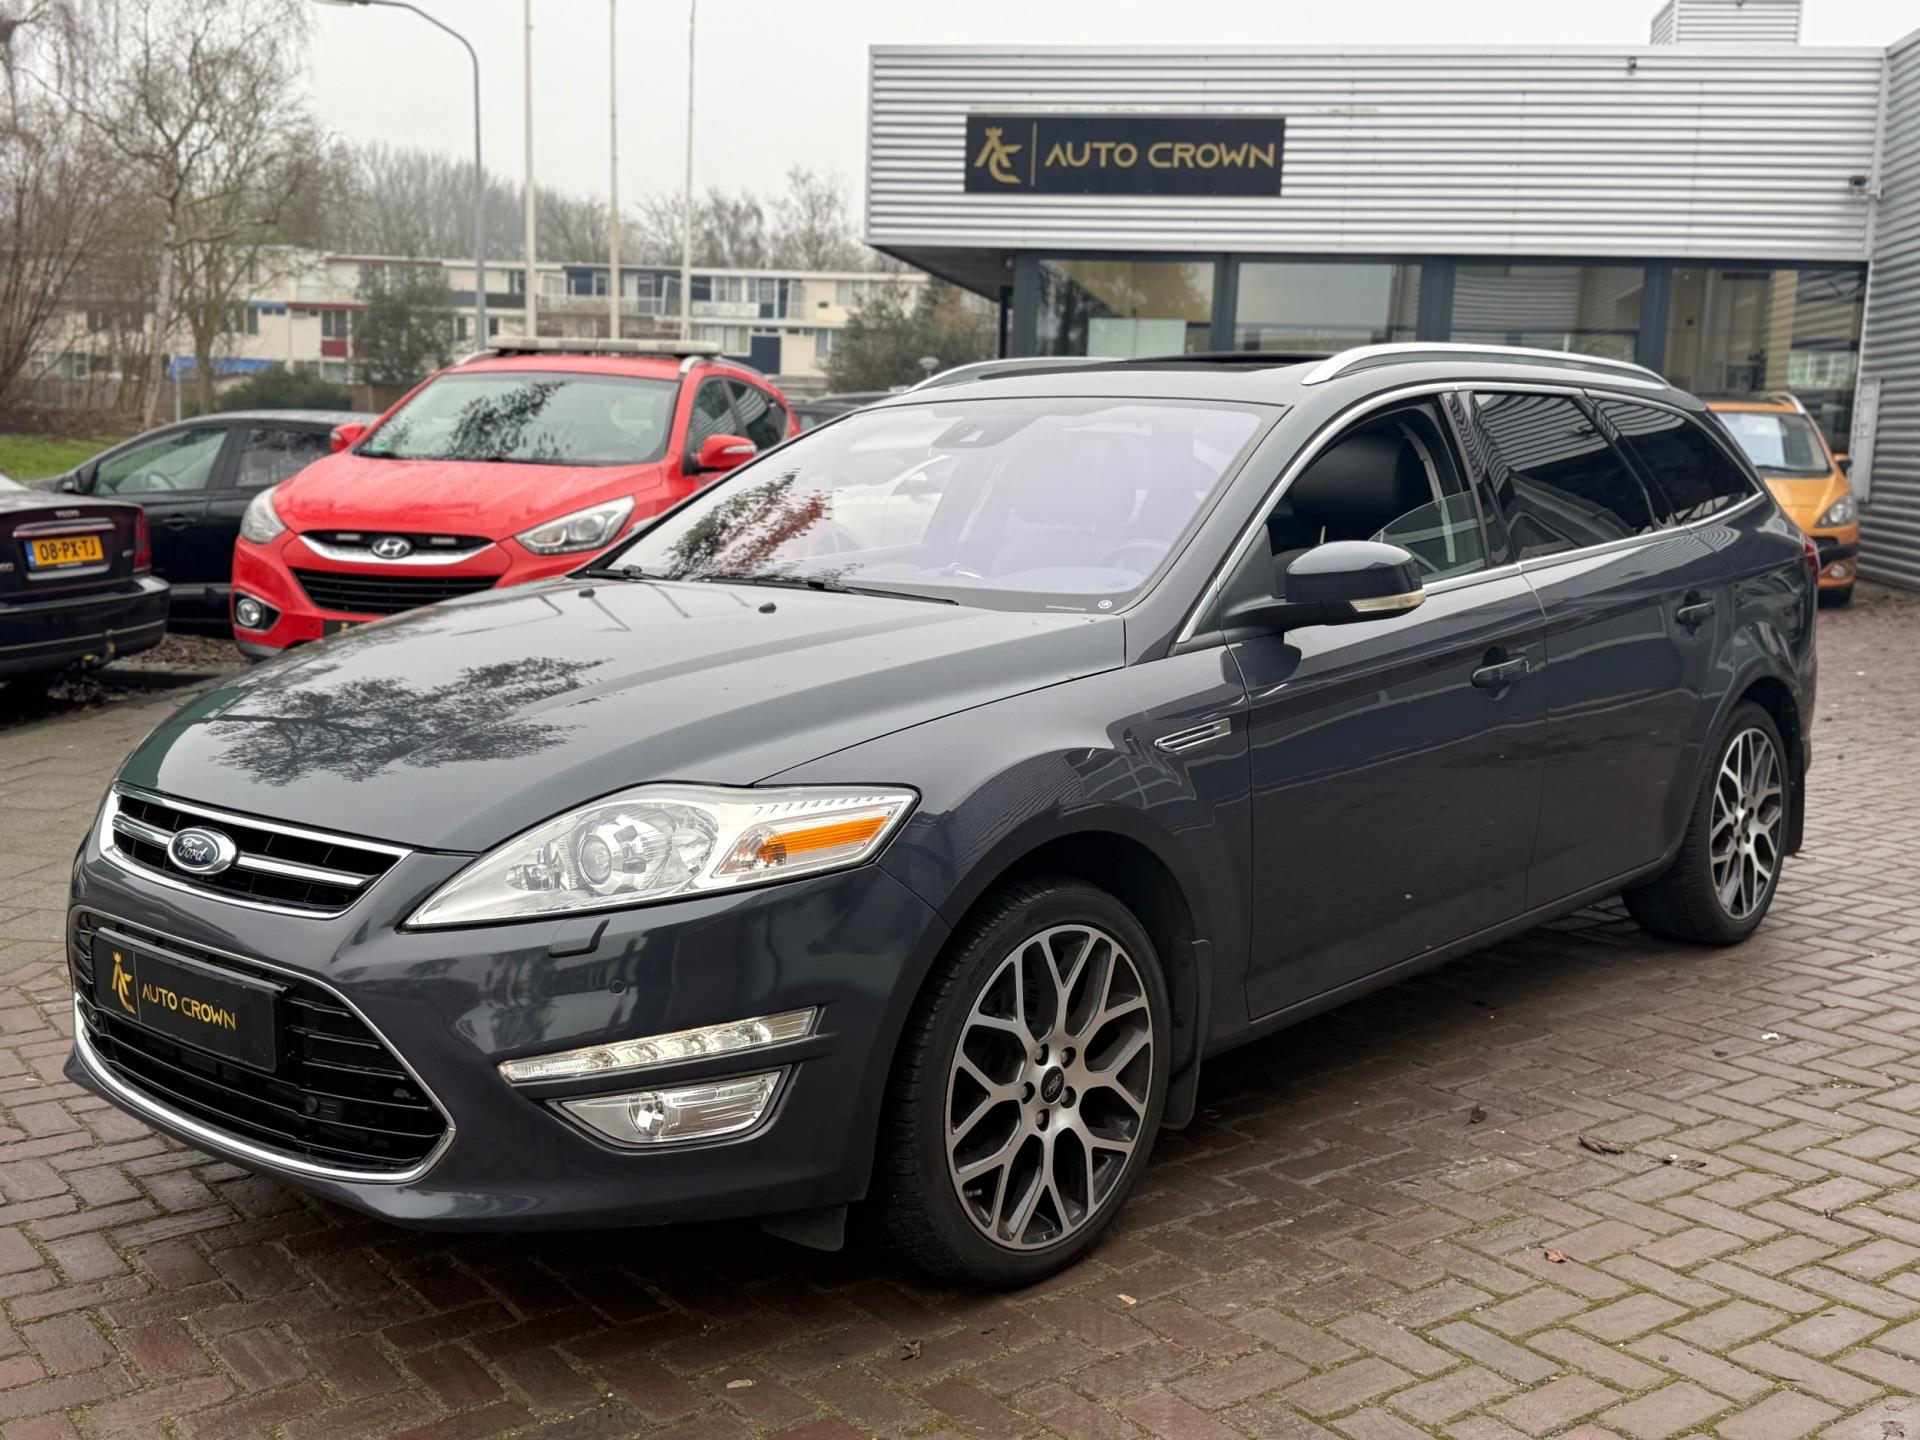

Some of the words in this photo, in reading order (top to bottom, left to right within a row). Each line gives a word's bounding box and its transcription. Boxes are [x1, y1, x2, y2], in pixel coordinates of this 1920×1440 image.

[1045, 142, 1138, 168] AUTO
[1148, 142, 1275, 169] CROWN
[39, 538, 97, 561] 08-PX-TJ
[177, 837, 208, 861] Ford
[142, 983, 178, 1011] AUTO
[181, 997, 236, 1031] CROWN
